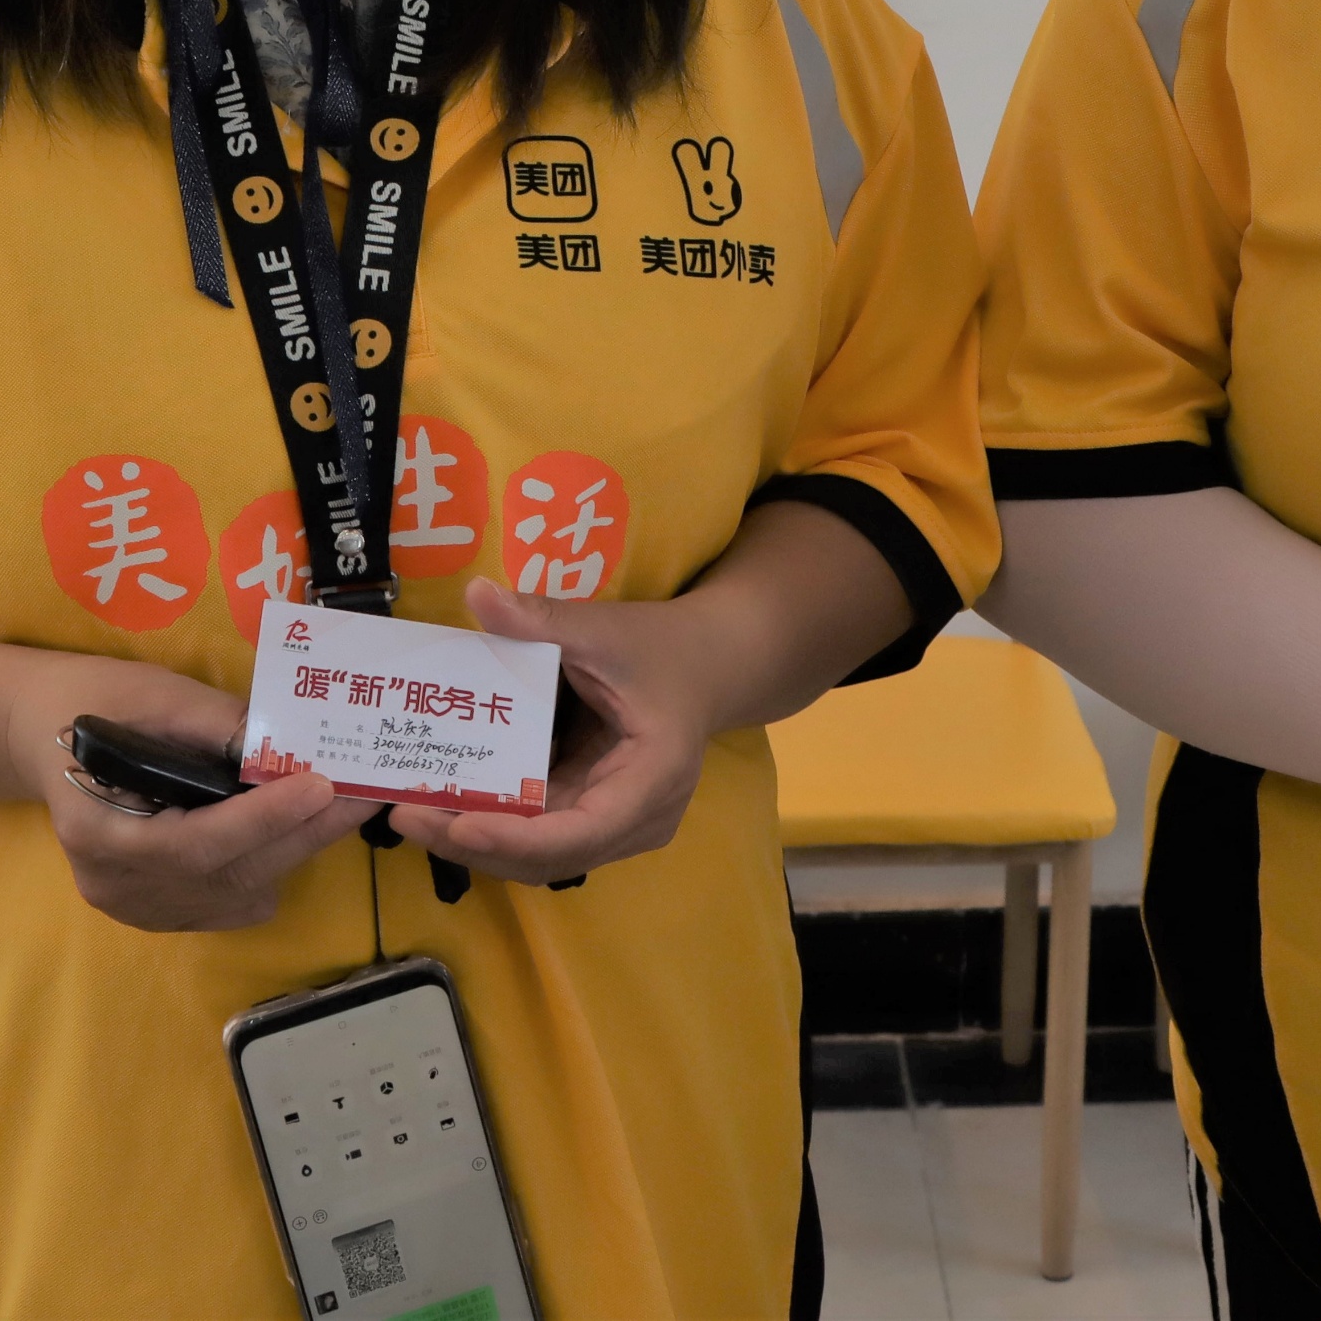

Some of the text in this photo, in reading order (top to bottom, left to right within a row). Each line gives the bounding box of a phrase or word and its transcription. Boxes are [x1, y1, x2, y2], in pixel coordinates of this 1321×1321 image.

[514, 162, 587, 197] 美团
[359, 180, 402, 292] SMILE
[515, 233, 601, 272] 美团
[640, 235, 775, 287] 美团外卖
[258, 246, 316, 362] SMILE
[294, 665, 514, 726] 暖“新”服务卡
[374, 754, 459, 776] 18260635718
